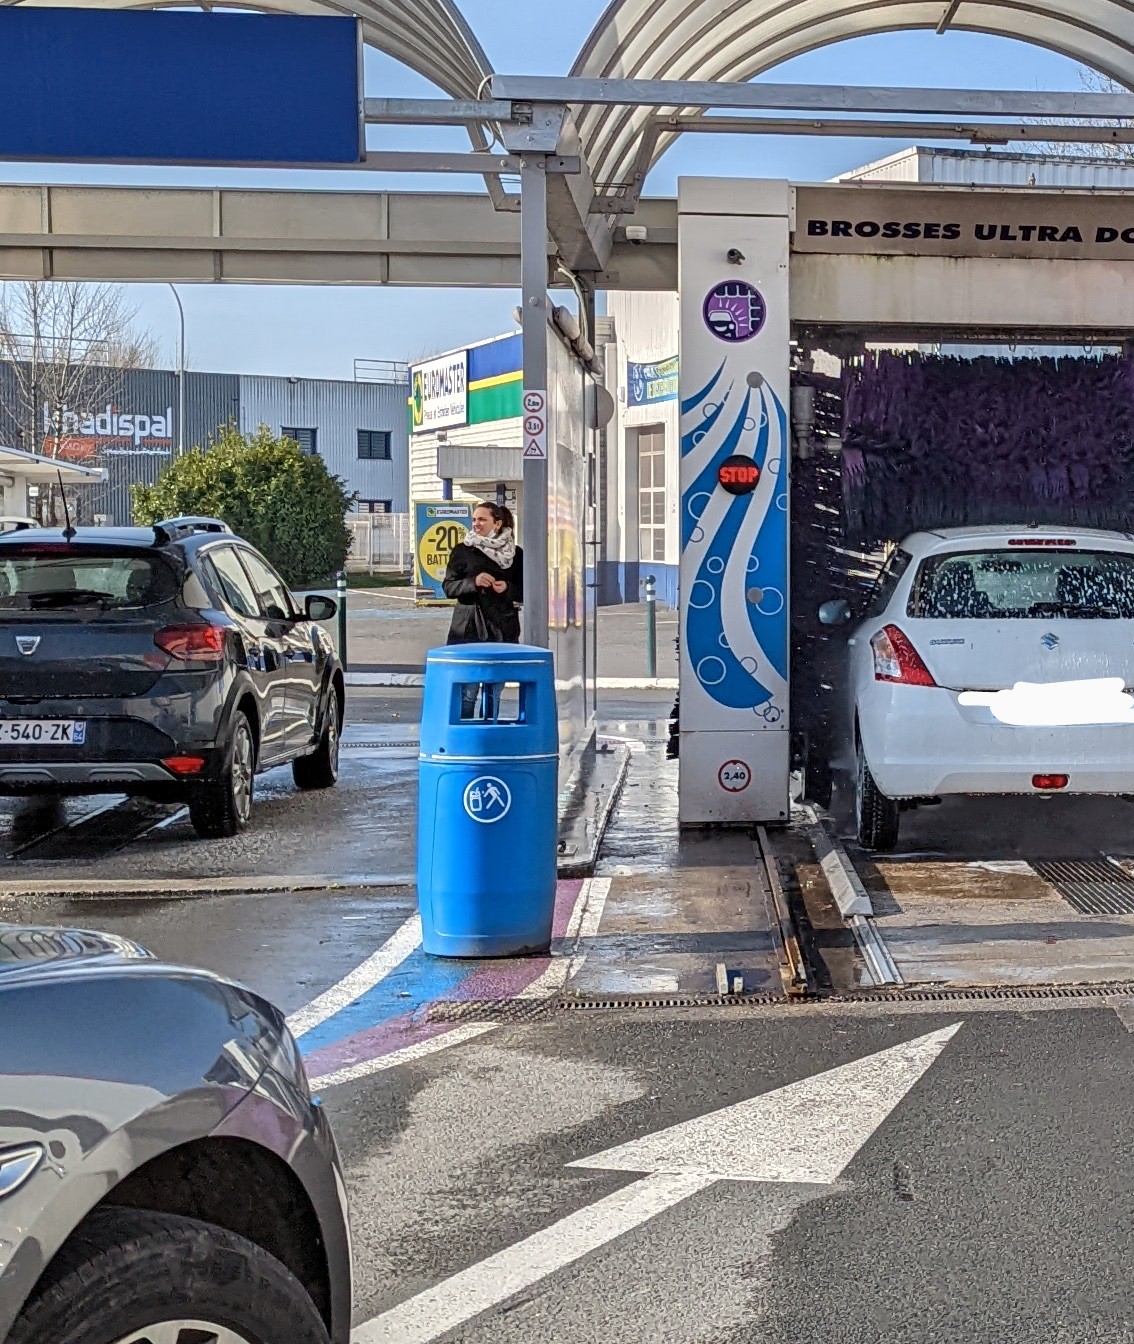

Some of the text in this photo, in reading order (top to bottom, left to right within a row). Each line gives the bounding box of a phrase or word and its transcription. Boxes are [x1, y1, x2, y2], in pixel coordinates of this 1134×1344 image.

[807, 220, 961, 239] BROSSES
[974, 224, 1083, 242] ULTRA
[423, 361, 465, 401] EUROMASTER
[719, 466, 759, 483] STOP
